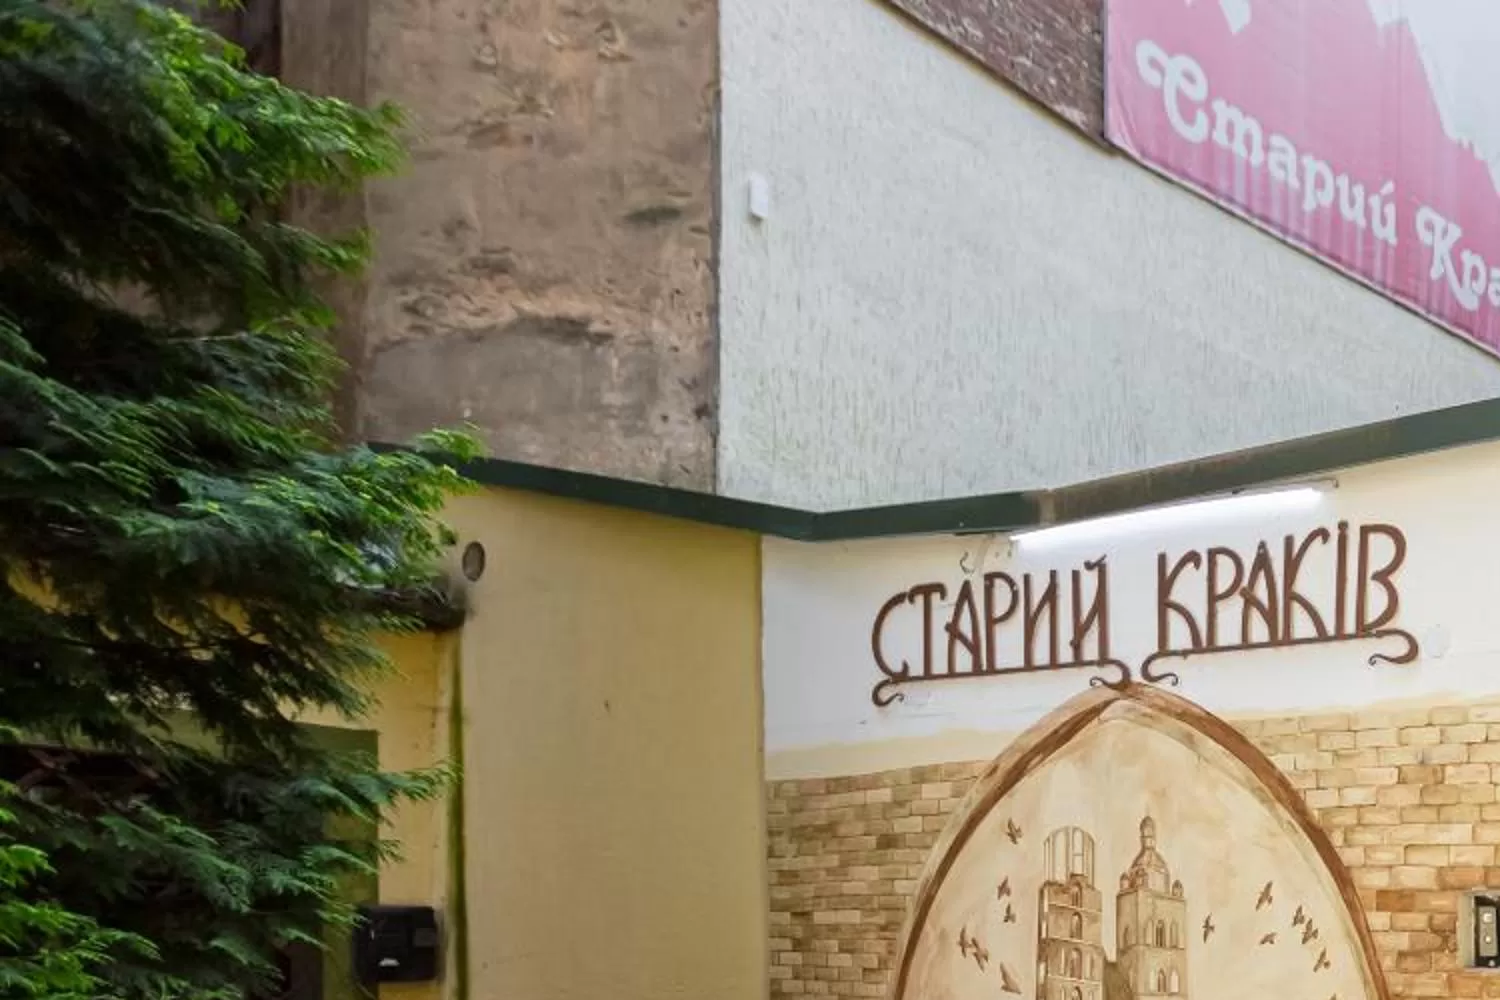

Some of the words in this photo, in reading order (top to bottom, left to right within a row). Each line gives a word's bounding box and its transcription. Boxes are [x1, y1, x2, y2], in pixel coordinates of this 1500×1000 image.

[1135, 39, 1398, 246] Старий
[871, 555, 1112, 684] СТАРИЙ
[1155, 519, 1409, 657] КРАКІВ
